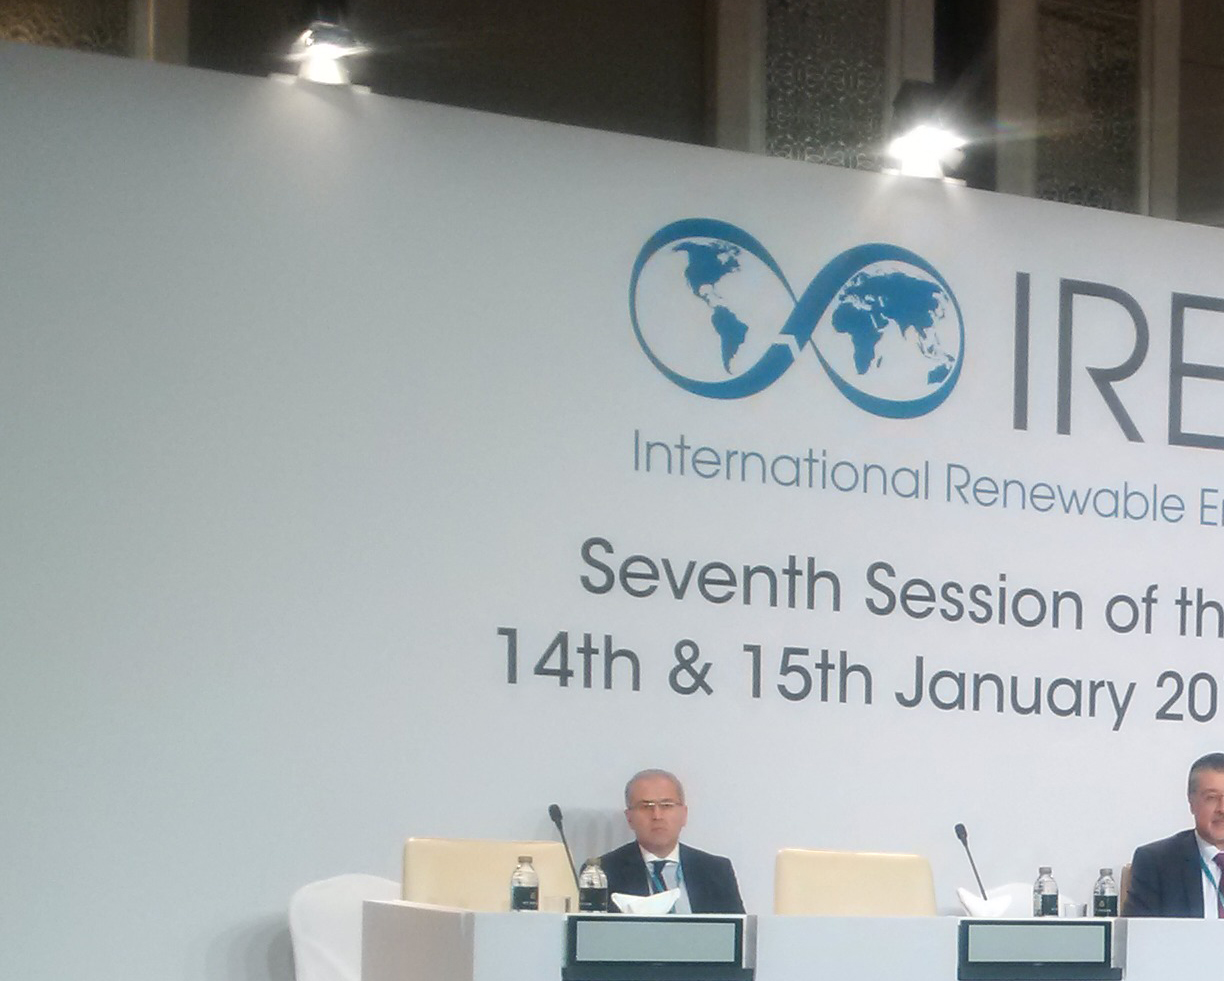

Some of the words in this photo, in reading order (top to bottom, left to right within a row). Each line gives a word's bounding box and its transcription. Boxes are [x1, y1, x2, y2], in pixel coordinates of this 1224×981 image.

[633, 429, 931, 502] International
[943, 462, 1185, 525] Renewable
[579, 536, 842, 613] Seventh
[864, 560, 1084, 631] Session
[1104, 583, 1159, 635] of
[496, 626, 641, 692] 14th
[667, 638, 714, 696] &
[742, 643, 873, 706] 15th
[894, 655, 1138, 732] January
